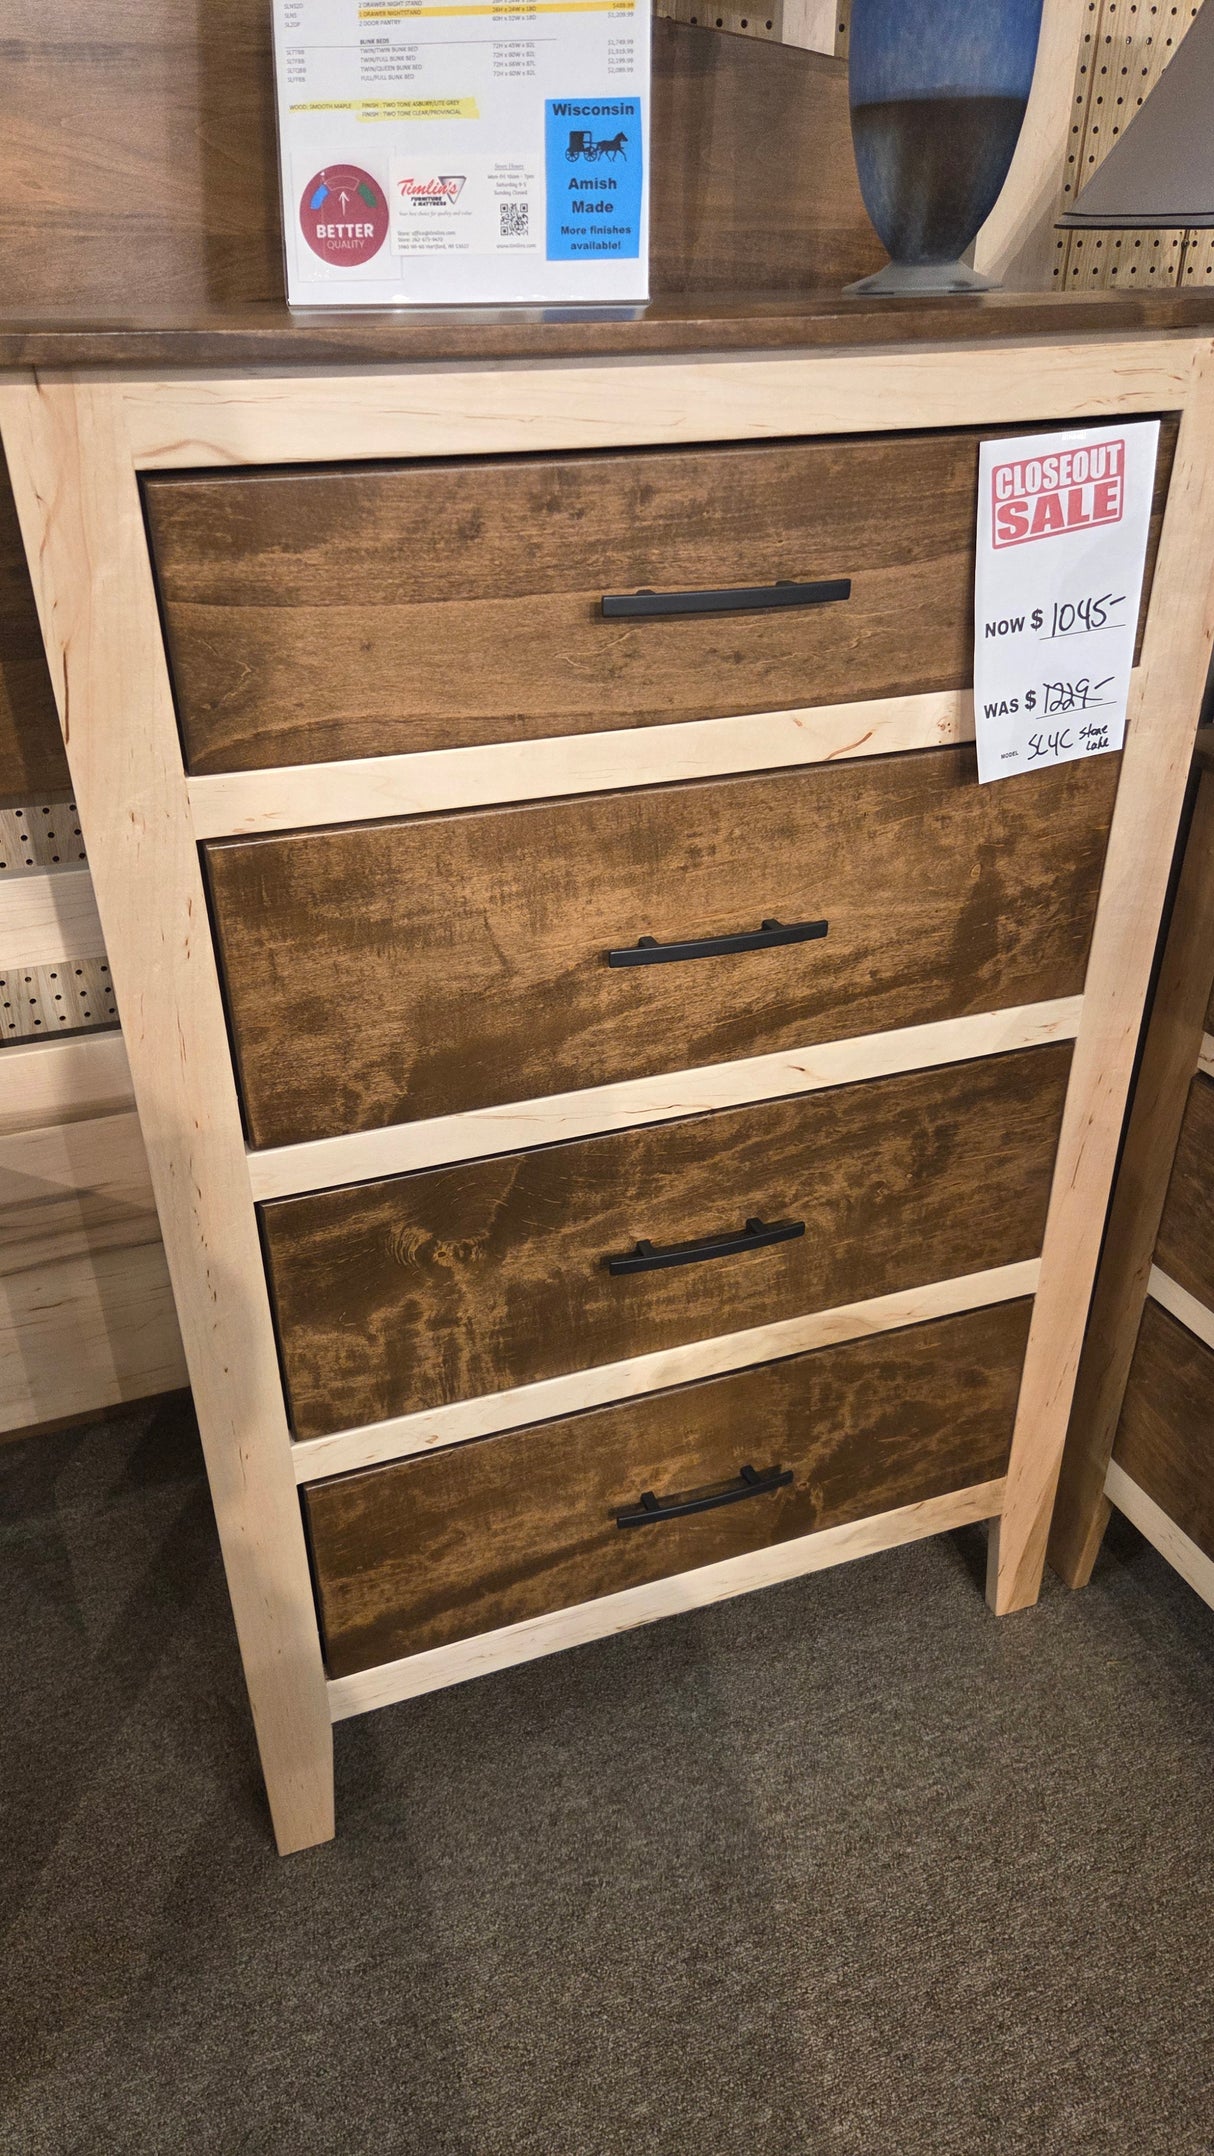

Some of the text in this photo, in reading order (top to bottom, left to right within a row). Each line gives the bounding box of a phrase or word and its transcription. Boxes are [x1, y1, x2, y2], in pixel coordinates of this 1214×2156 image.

[552, 103, 635, 116] Wisconsin
[397, 178, 458, 196] Timlin's
[568, 178, 617, 190] Amish
[572, 200, 614, 213] Made
[316, 223, 374, 238] BETTER
[560, 225, 632, 235] More finishes
[327, 240, 365, 250] QUALITY
[570, 241, 621, 250] available!
[995, 442, 1122, 501] CLOSEOUT
[997, 480, 1119, 541] SALE
[985, 616, 1026, 639] NOW
[983, 698, 1020, 719] WAS
[1000, 750, 1019, 759] MODEL
[1027, 728, 1074, 760] SL4C
